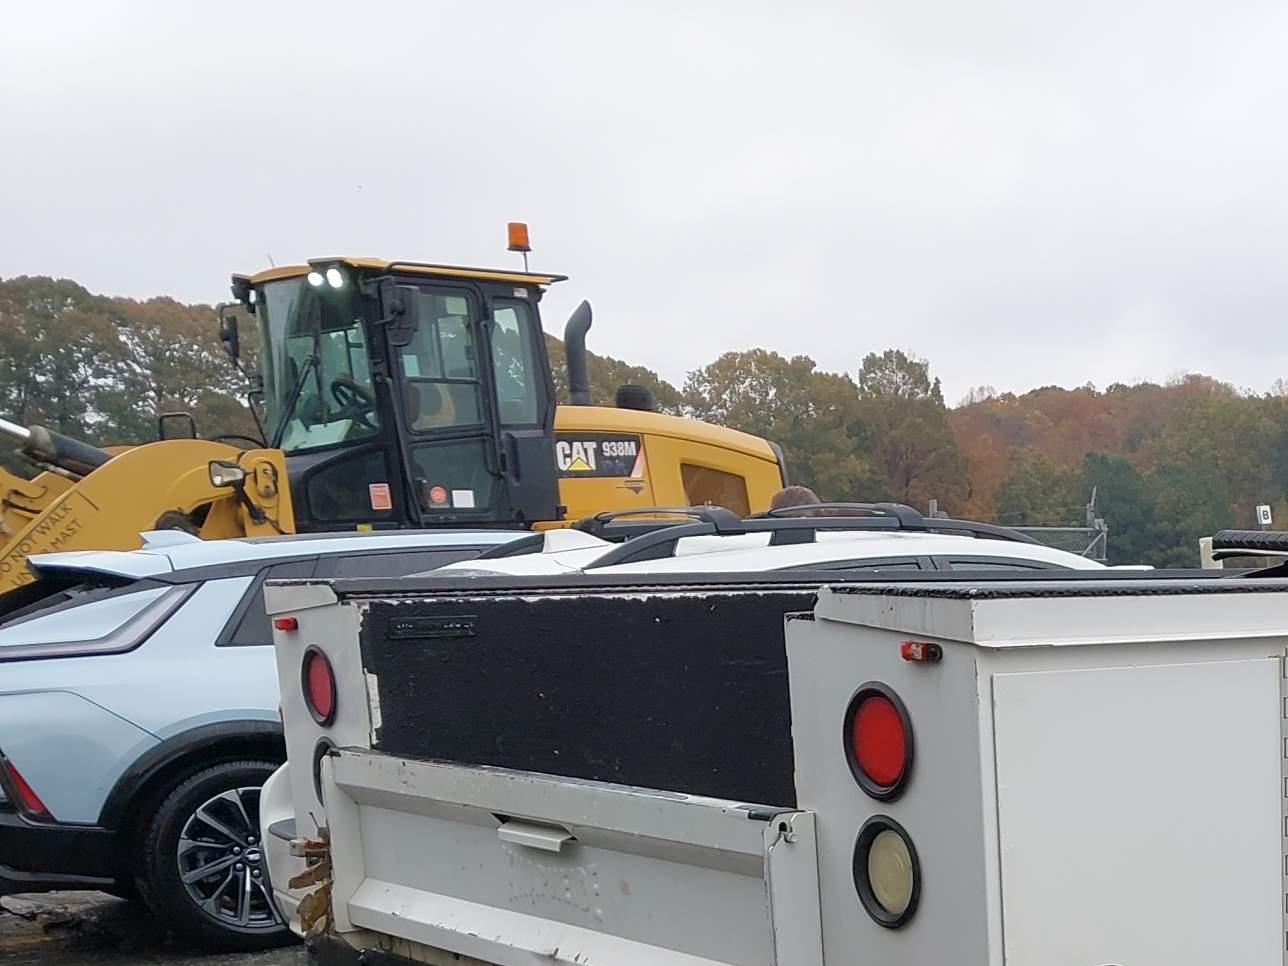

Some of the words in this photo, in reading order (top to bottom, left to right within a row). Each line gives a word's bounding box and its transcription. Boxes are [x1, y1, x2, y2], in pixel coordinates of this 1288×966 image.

[556, 441, 597, 471] CAT
[602, 441, 637, 456] 938M
[1263, 510, 1269, 520] B
[10, 534, 38, 562] NOT
[36, 502, 73, 536] WALK
[50, 518, 82, 550] MAST
